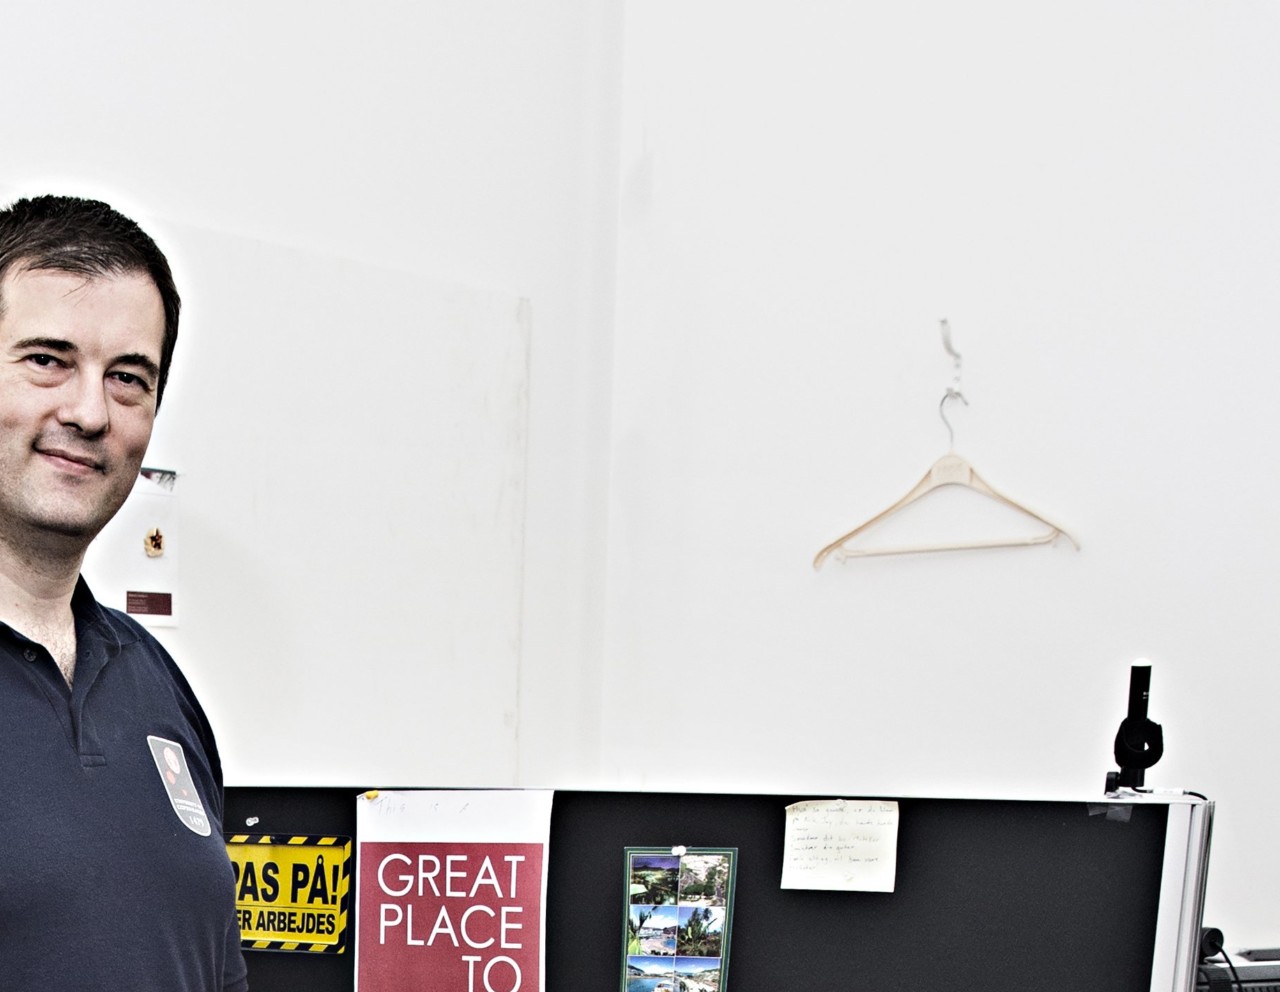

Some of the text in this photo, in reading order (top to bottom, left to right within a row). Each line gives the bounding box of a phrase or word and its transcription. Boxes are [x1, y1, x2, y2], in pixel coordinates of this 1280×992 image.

[291, 854, 339, 905] PÅ!
[377, 853, 526, 899] GREAT
[256, 910, 336, 935] ARBEJDES
[379, 903, 523, 949] PLACE
